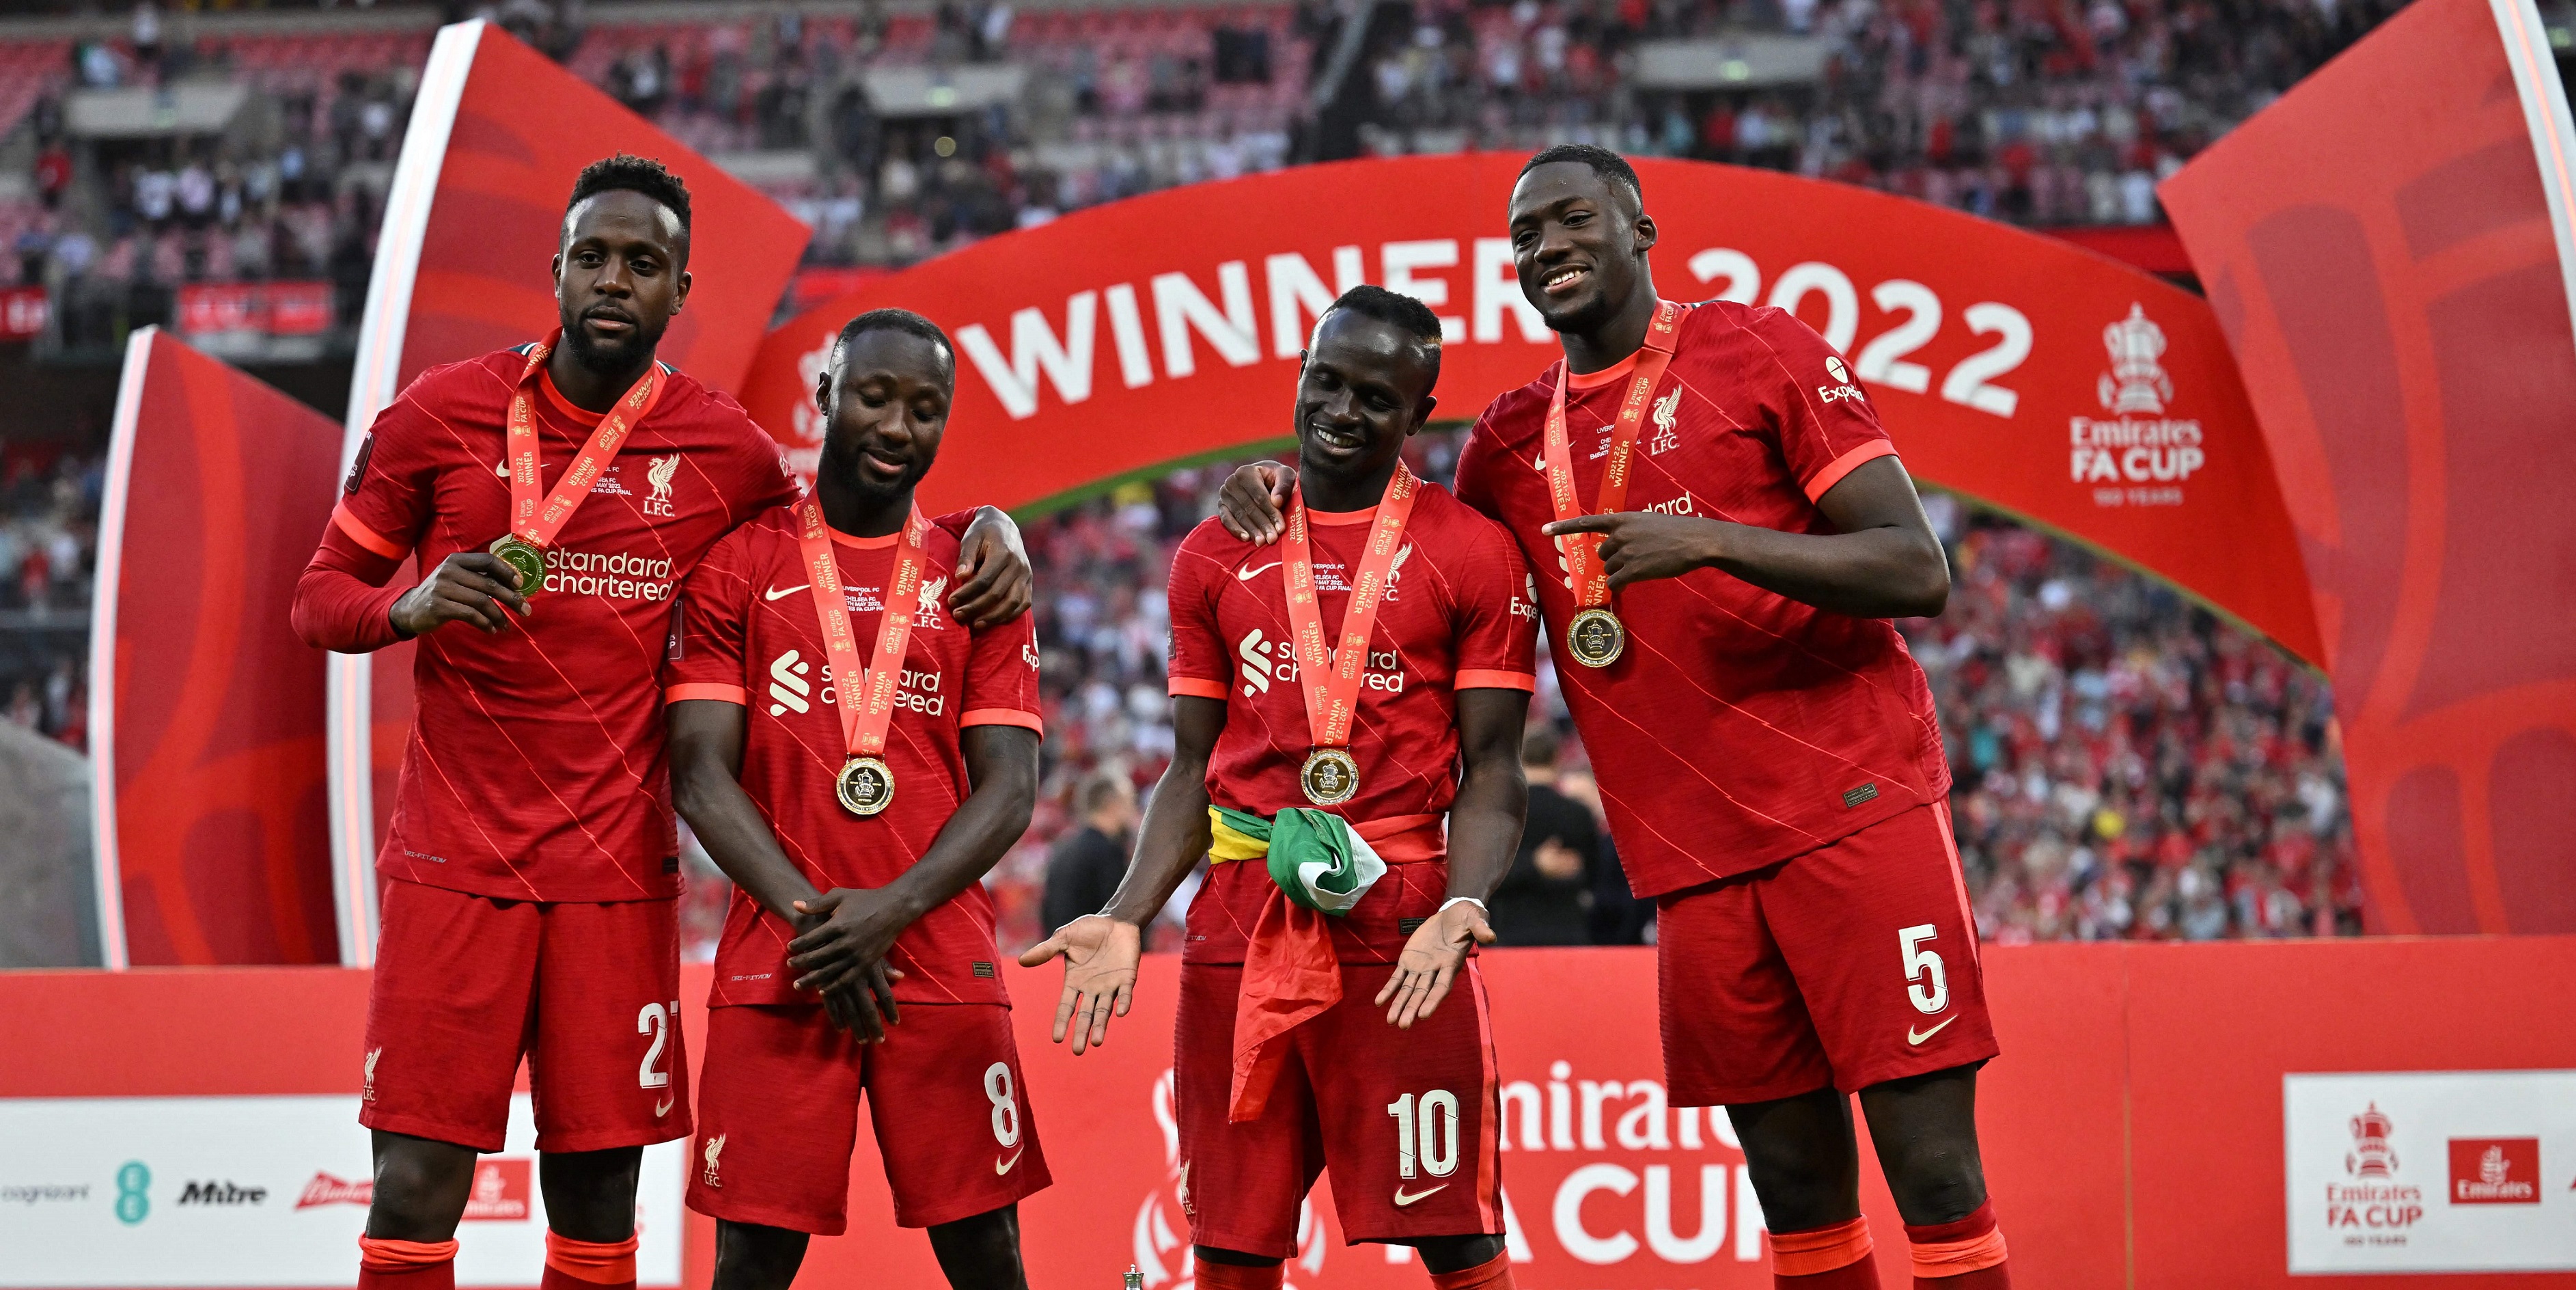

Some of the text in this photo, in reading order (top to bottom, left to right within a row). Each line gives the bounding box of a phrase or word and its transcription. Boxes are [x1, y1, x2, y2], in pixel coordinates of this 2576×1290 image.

[1687, 247, 2033, 419] 2022
[628, 376, 653, 407] WINNER
[1629, 376, 1644, 404] Emirates
[1634, 396, 1643, 406] FA
[1639, 378, 1649, 395] CUP
[521, 413, 527, 422] FA
[1549, 420, 1555, 432] FA
[1596, 424, 1615, 434] LIVERP
[2069, 415, 2203, 448] Emirates
[599, 435, 610, 448] CUP
[604, 432, 620, 452] Emirates
[1590, 450, 1609, 460] EMIRAT
[1651, 436, 1680, 457] L.F.C.
[524, 451, 534, 486] WINNER
[568, 456, 594, 486] WINNER
[580, 465, 597, 486] 2021-22
[1609, 446, 1621, 480] 2021-22
[1614, 440, 1630, 488] WINNER
[2071, 445, 2205, 482] FA CUP
[1391, 465, 1407, 500] WINNER
[1402, 474, 1413, 499] 2021-22
[1551, 465, 1566, 512] WINNER
[1560, 469, 1570, 502] 2021-22
[526, 509, 534, 517] FA
[543, 510, 554, 521] CUP
[643, 502, 675, 517] L.F.C.
[803, 506, 812, 530] Emirates
[807, 504, 817, 518] CUP
[812, 518, 819, 527] FA
[1295, 504, 1304, 545] WINNER
[1379, 530, 1388, 539] FA
[1374, 538, 1385, 555] CUP
[1381, 530, 1395, 556] Emirates
[1571, 546, 1579, 560] FA
[1577, 544, 1587, 566] Emira
[546, 547, 671, 579] standard
[814, 560, 826, 588] 2021-22
[820, 553, 837, 593] WINNER
[1292, 562, 1301, 589] Emirates
[1298, 561, 1308, 588] FA CUP
[1574, 559, 1585, 575] CUP
[543, 571, 673, 601] chartered
[896, 559, 912, 596] WINNER
[907, 567, 918, 592] 2021-22
[1593, 575, 1606, 606] NNER
[1353, 571, 1374, 614] WINNER
[1365, 578, 1379, 609] 2021-22
[828, 609, 839, 637] Emirates
[834, 609, 844, 627] CUP
[838, 627, 846, 636] FA
[885, 627, 897, 654] FA CUP
[892, 628, 904, 655] Emirates
[1302, 629, 1314, 661] 2021-22
[1309, 620, 1324, 667] WINNER
[1342, 650, 1353, 679] FA CUP
[1348, 651, 1360, 679] Emirates
[842, 677, 855, 709] 2021-22
[869, 671, 887, 715] WINNER
[880, 678, 893, 711] 2021-22
[1324, 698, 1342, 744] WINNER
[1335, 707, 1348, 740] 2021-22
[1898, 923, 1950, 1015] 5
[638, 1000, 678, 1088] 2
[984, 1061, 1021, 1148] 8
[1387, 1090, 1459, 1179] 10
[178, 1179, 267, 1205] Mitre
[2326, 1183, 2422, 1204] Emirates
[2458, 1179, 2532, 1199] Emirates
[2327, 1205, 2423, 1228] FA CUP
